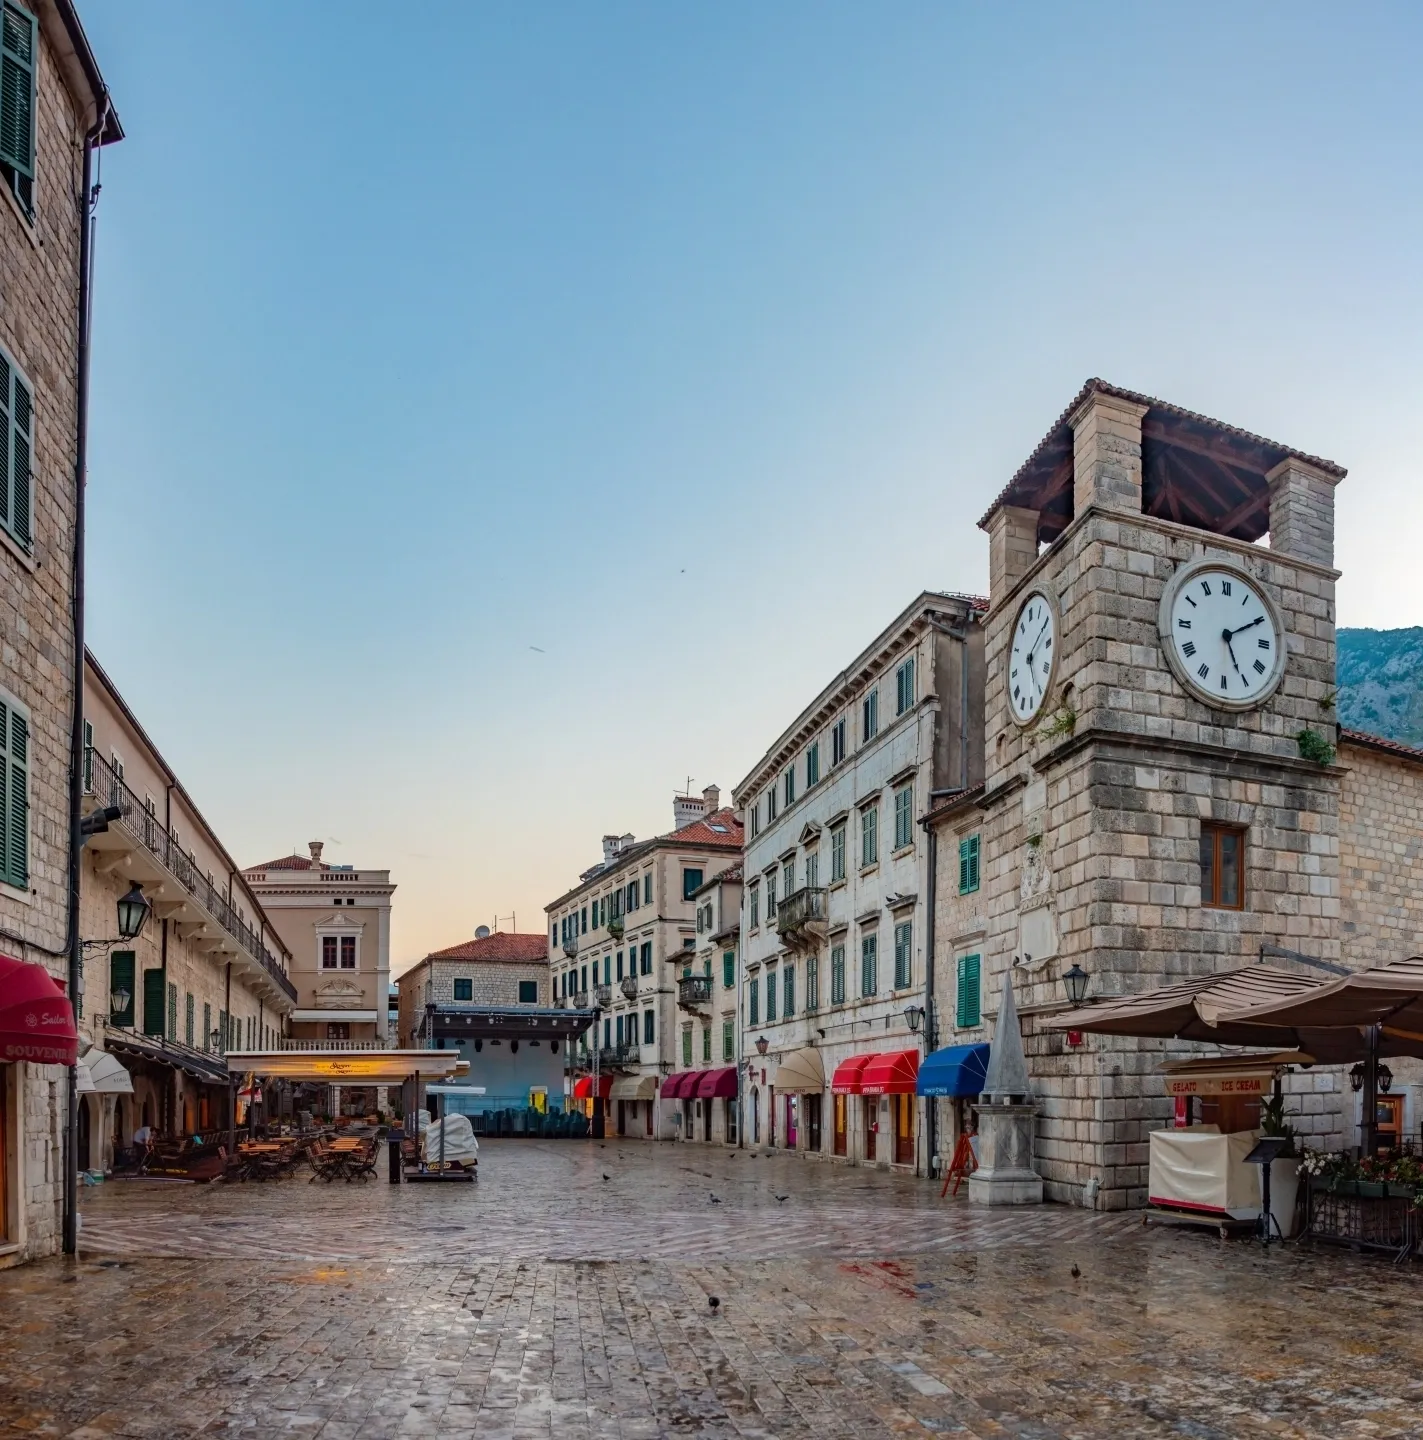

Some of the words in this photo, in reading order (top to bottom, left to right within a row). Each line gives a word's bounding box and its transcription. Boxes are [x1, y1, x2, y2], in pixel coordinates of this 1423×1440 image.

[1222, 580, 1232, 597] XII
[1185, 595, 1197, 608] X
[1242, 595, 1249, 606] I
[1258, 639, 1270, 650] III
[1241, 674, 1249, 687] V
[1172, 1081, 1197, 1092] GELATO
[1221, 1081, 1233, 1092] ICE
[1236, 1080, 1261, 1091] CREAM
